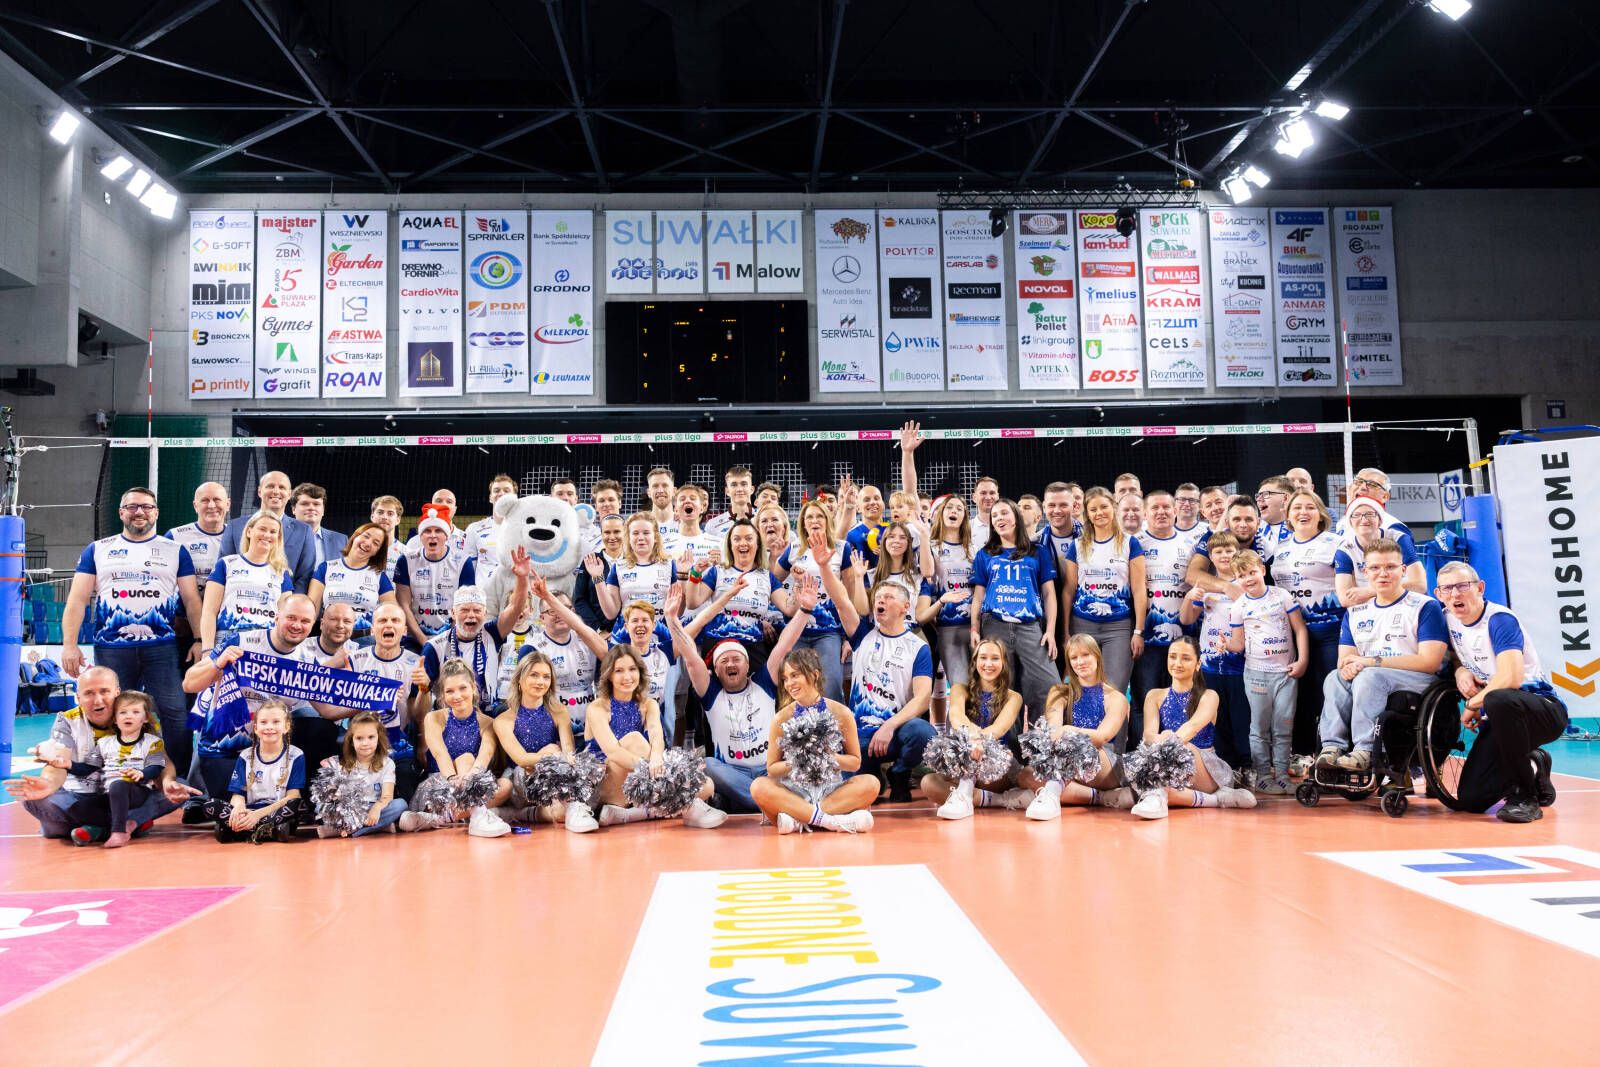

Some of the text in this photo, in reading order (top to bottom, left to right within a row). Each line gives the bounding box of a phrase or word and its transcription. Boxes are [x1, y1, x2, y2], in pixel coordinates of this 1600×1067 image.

[262, 216, 316, 233] majster
[402, 217, 458, 229] AQUAEL
[1162, 213, 1188, 225] PGK
[613, 219, 796, 244] SUWAŁKI
[1286, 228, 1314, 242] 4F
[276, 249, 300, 257] ZBM
[328, 252, 383, 275] Garden
[737, 264, 800, 278] Malow
[1154, 271, 1198, 279] WALMAR
[281, 269, 302, 291] 5
[1096, 289, 1136, 298] melius
[1147, 298, 1200, 307] KRAM
[191, 308, 249, 322] PKS NOVA
[1036, 314, 1067, 322] Natur
[342, 330, 382, 339] ASTWA
[821, 330, 874, 338] SERWISTAL
[905, 337, 940, 347] PWiK
[1033, 336, 1075, 346] linkgroup
[1029, 365, 1070, 373] APTEKA
[552, 374, 590, 382] LEWIATAN
[1088, 370, 1139, 382] BOSS
[210, 379, 249, 392] printly
[280, 379, 310, 391] grafit
[1390, 486, 1436, 500] LINKA
[1541, 451, 1591, 651] KRISHOME
[1004, 564, 1020, 581] 11
[948, 581, 973, 589] boun
[112, 588, 160, 598] bounce
[1147, 589, 1186, 598] bounc
[236, 605, 275, 618] bounce
[724, 608, 762, 620] bounce
[250, 653, 381, 683] KLUB KIBICA MKS
[237, 660, 397, 702] LEPSK MALOW SUWAŁKI
[250, 681, 371, 709] BIAŁO NIEBIESKA ARMIA
[728, 740, 769, 760] bounce
[708, 869, 880, 969] POGODNE
